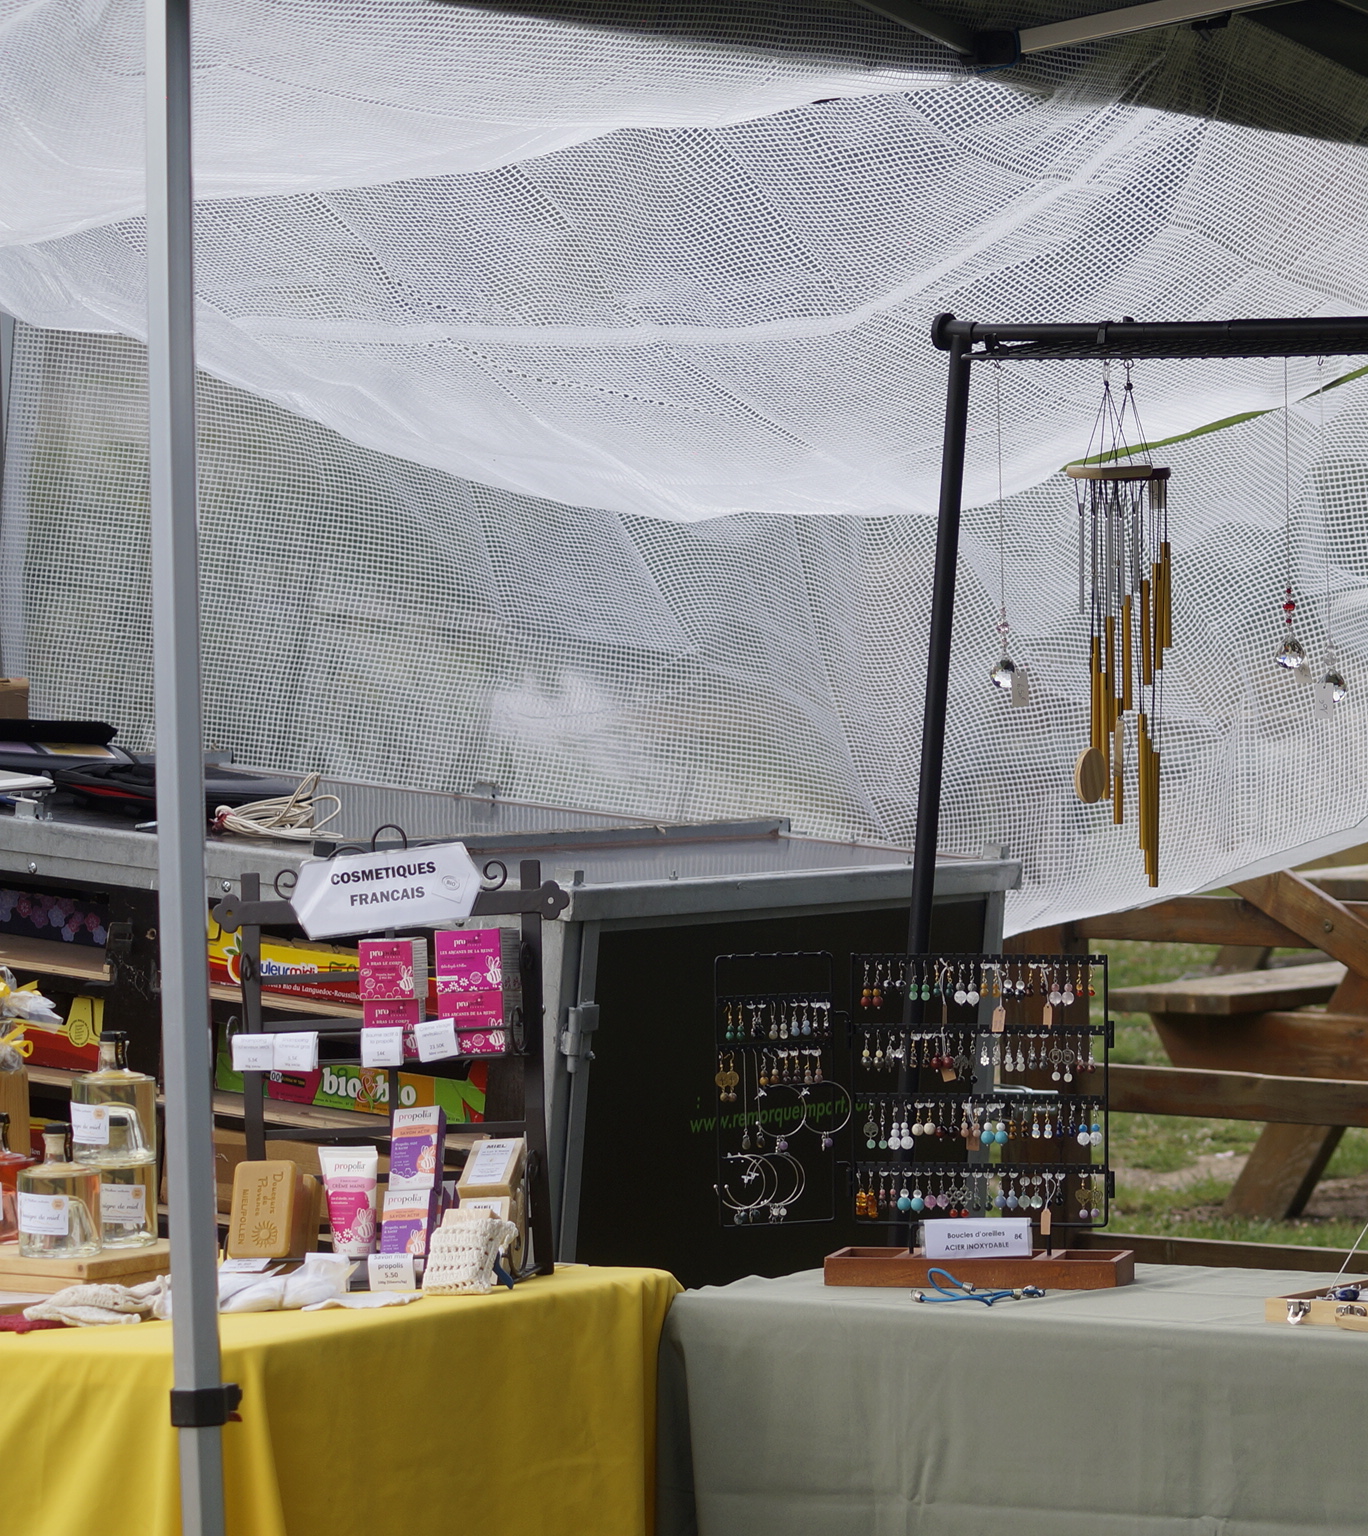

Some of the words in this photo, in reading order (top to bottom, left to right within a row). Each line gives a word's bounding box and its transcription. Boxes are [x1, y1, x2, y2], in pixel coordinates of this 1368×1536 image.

[331, 861, 436, 886] COSMETIQUES
[350, 886, 426, 906] FRANCAIS
[260, 962, 316, 976] uleurmidi
[302, 985, 360, 1000] Languedoc-Roussillo
[322, 1067, 416, 1106] bio&bo
[399, 1110, 431, 1122] propolia
[690, 1096, 876, 1134] www.remorqueimport.om
[334, 1161, 366, 1172] propolia
[255, 1176, 268, 1216] Provence
[388, 1194, 422, 1205] propolia
[966, 1241, 1010, 1250] INOXYDABLE
